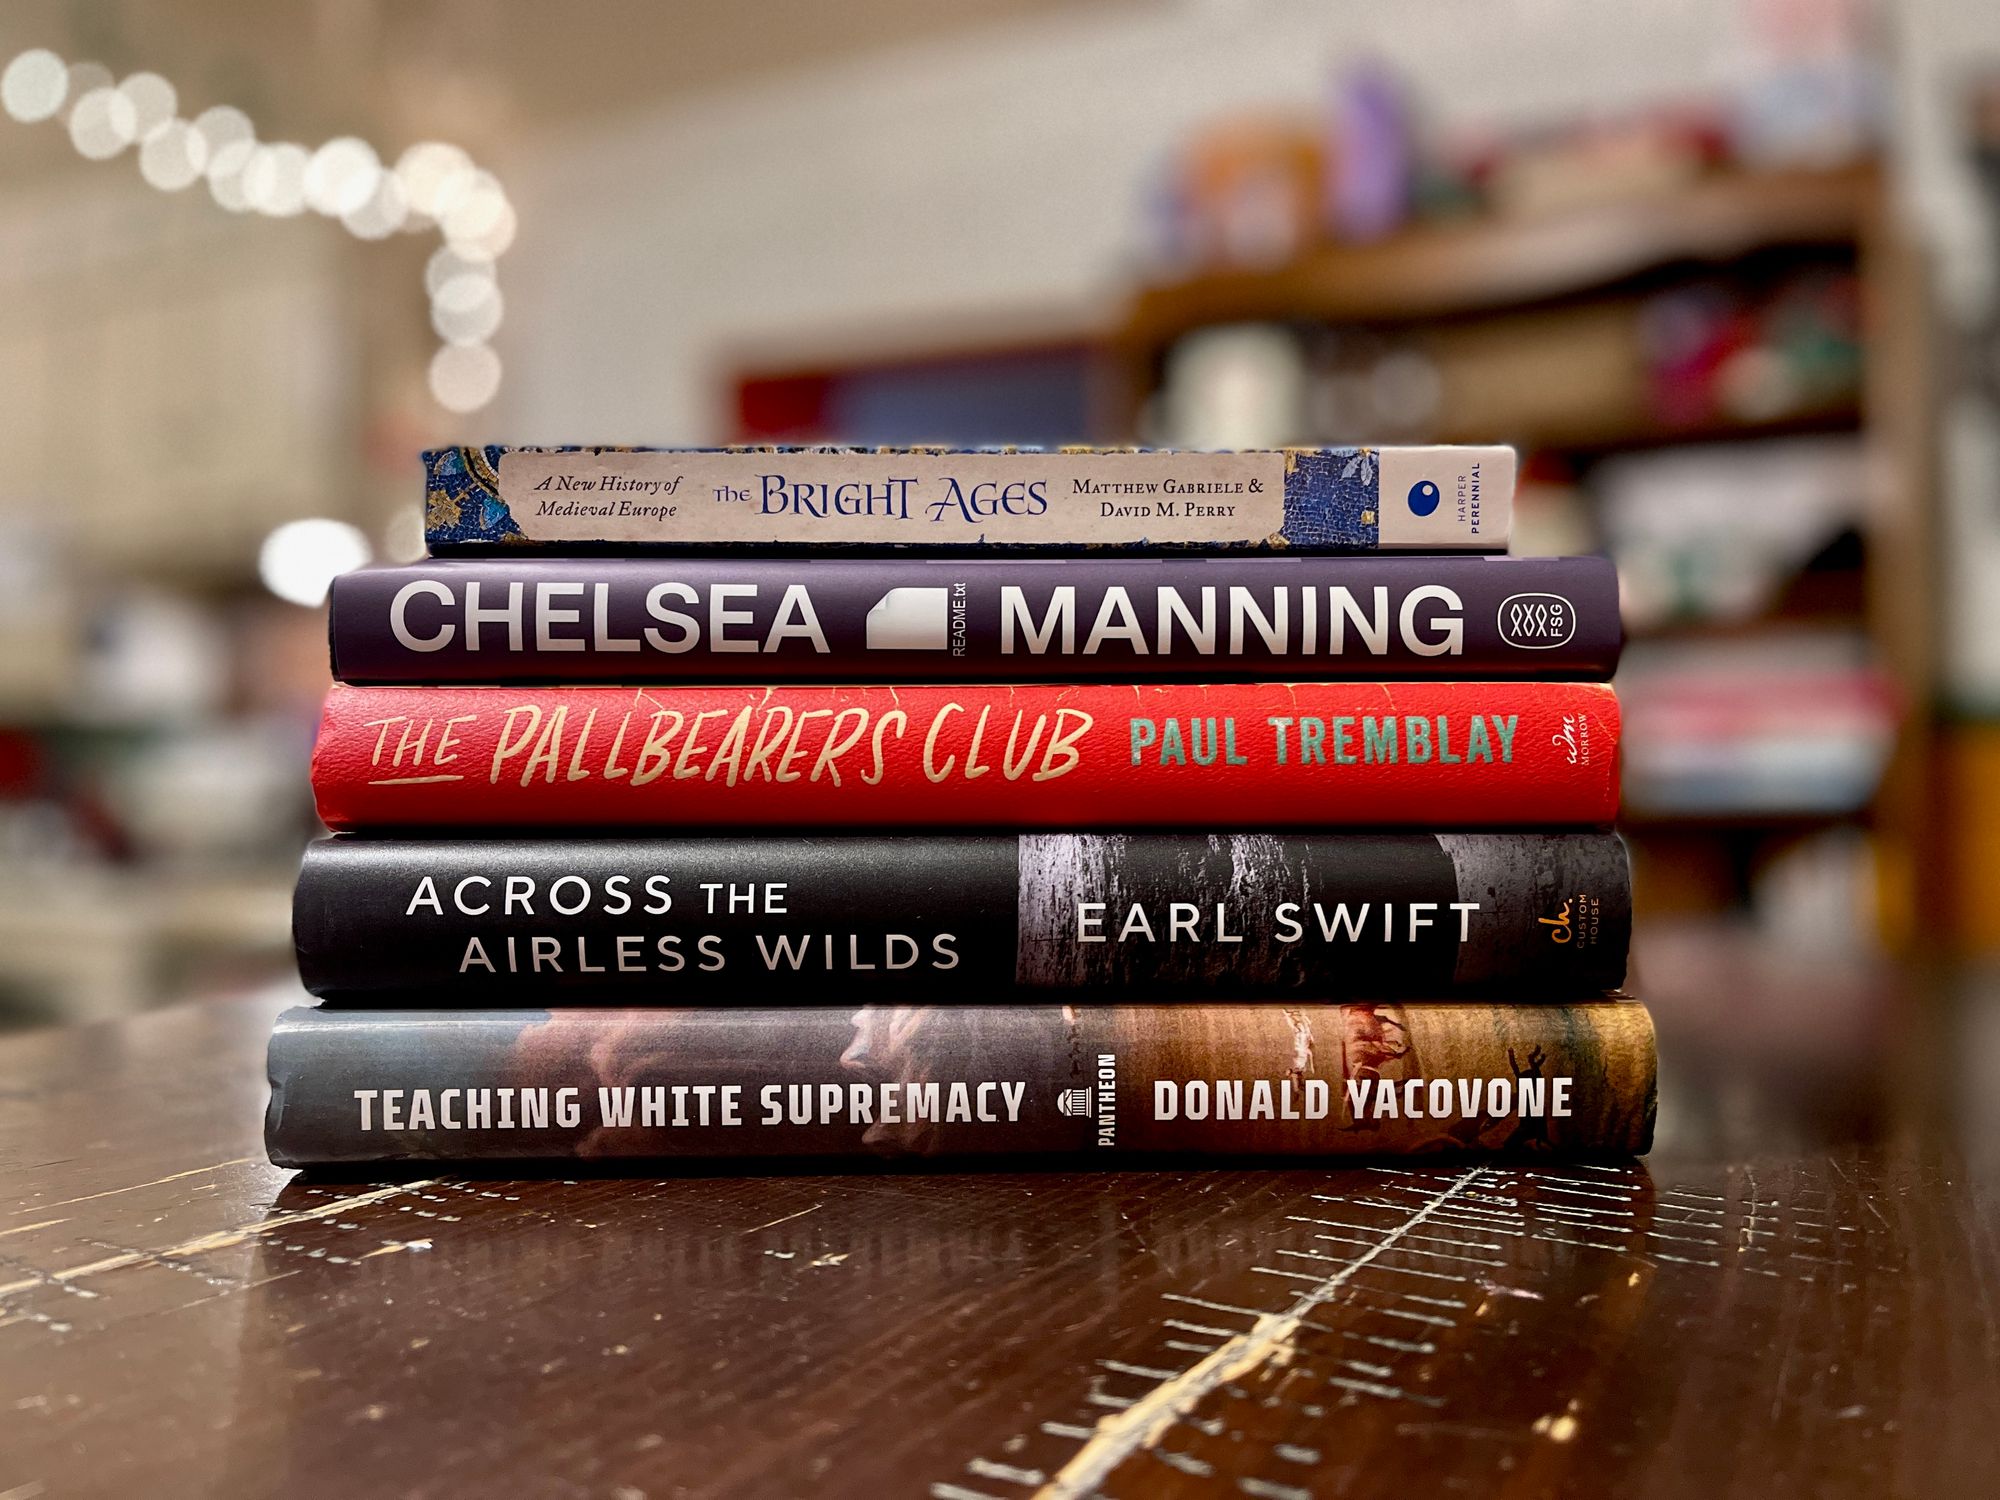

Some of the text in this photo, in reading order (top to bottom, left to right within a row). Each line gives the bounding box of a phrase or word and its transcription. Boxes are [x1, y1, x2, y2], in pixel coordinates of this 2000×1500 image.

[534, 476, 684, 495] A New History of
[754, 474, 919, 521] BRIGHT
[925, 477, 1048, 523] AGES
[1073, 479, 1264, 494] MATTHEW GABRIELE &
[1457, 475, 1467, 522] HARPER
[1471, 462, 1480, 534] PERENNIAL
[536, 501, 677, 521] Medieval Europe
[1100, 502, 1236, 517] DAVID M. PERRY
[389, 580, 1464, 657] CHELSEA MANNING
[952, 582, 967, 658] README.txt
[1550, 604, 1563, 637] FSG
[363, 702, 1094, 788] THE PALLBEARERS CLUB
[1130, 714, 1519, 766] PAUL TREMBLAY
[1578, 713, 1590, 766] MORROW
[405, 875, 788, 916] ACROSS THE
[1077, 902, 1480, 943] EARL SWIFT
[1576, 894, 1587, 948] CUSTOM
[1590, 898, 1600, 944] HOUSE
[458, 933, 960, 973] AIRLESS WILDS
[354, 1081, 1026, 1132] TEACHING WHITE SUPREMACY
[1097, 1054, 1115, 1146] PANTHEON
[1154, 1077, 1573, 1121] DONALD YACOVONE
